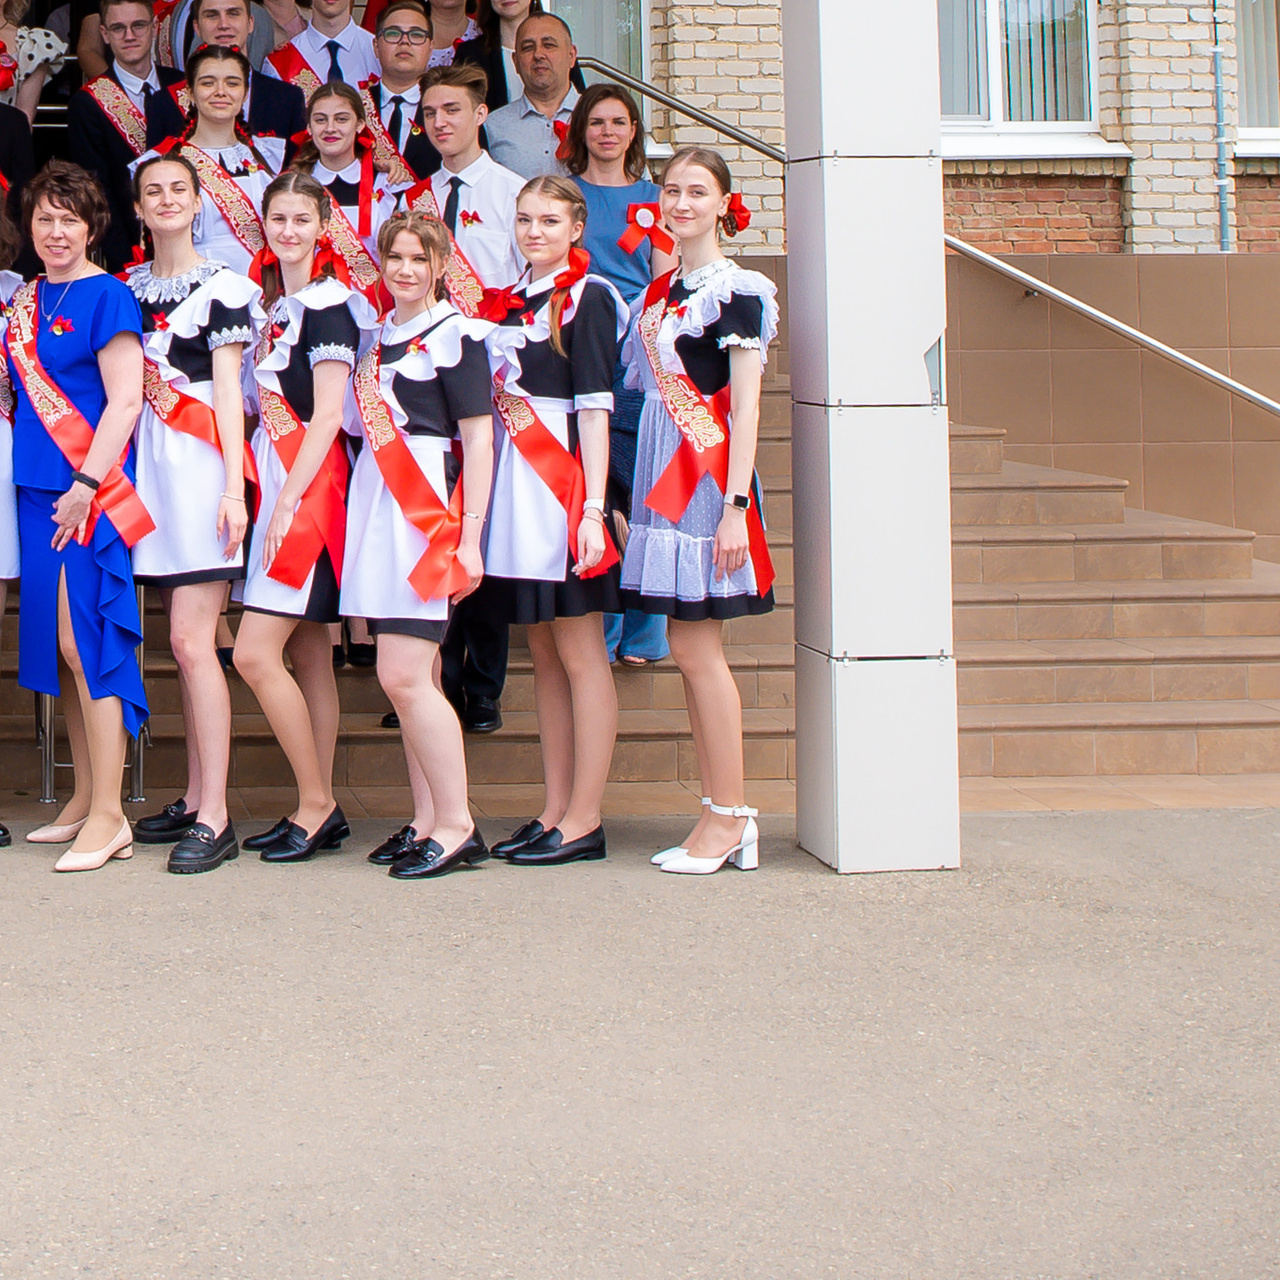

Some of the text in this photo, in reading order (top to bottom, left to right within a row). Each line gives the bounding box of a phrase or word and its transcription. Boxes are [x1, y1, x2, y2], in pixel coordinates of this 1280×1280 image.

[263, 394, 298, 436] 2023
[367, 404, 396, 447] 2023
[683, 404, 725, 449] 2023
